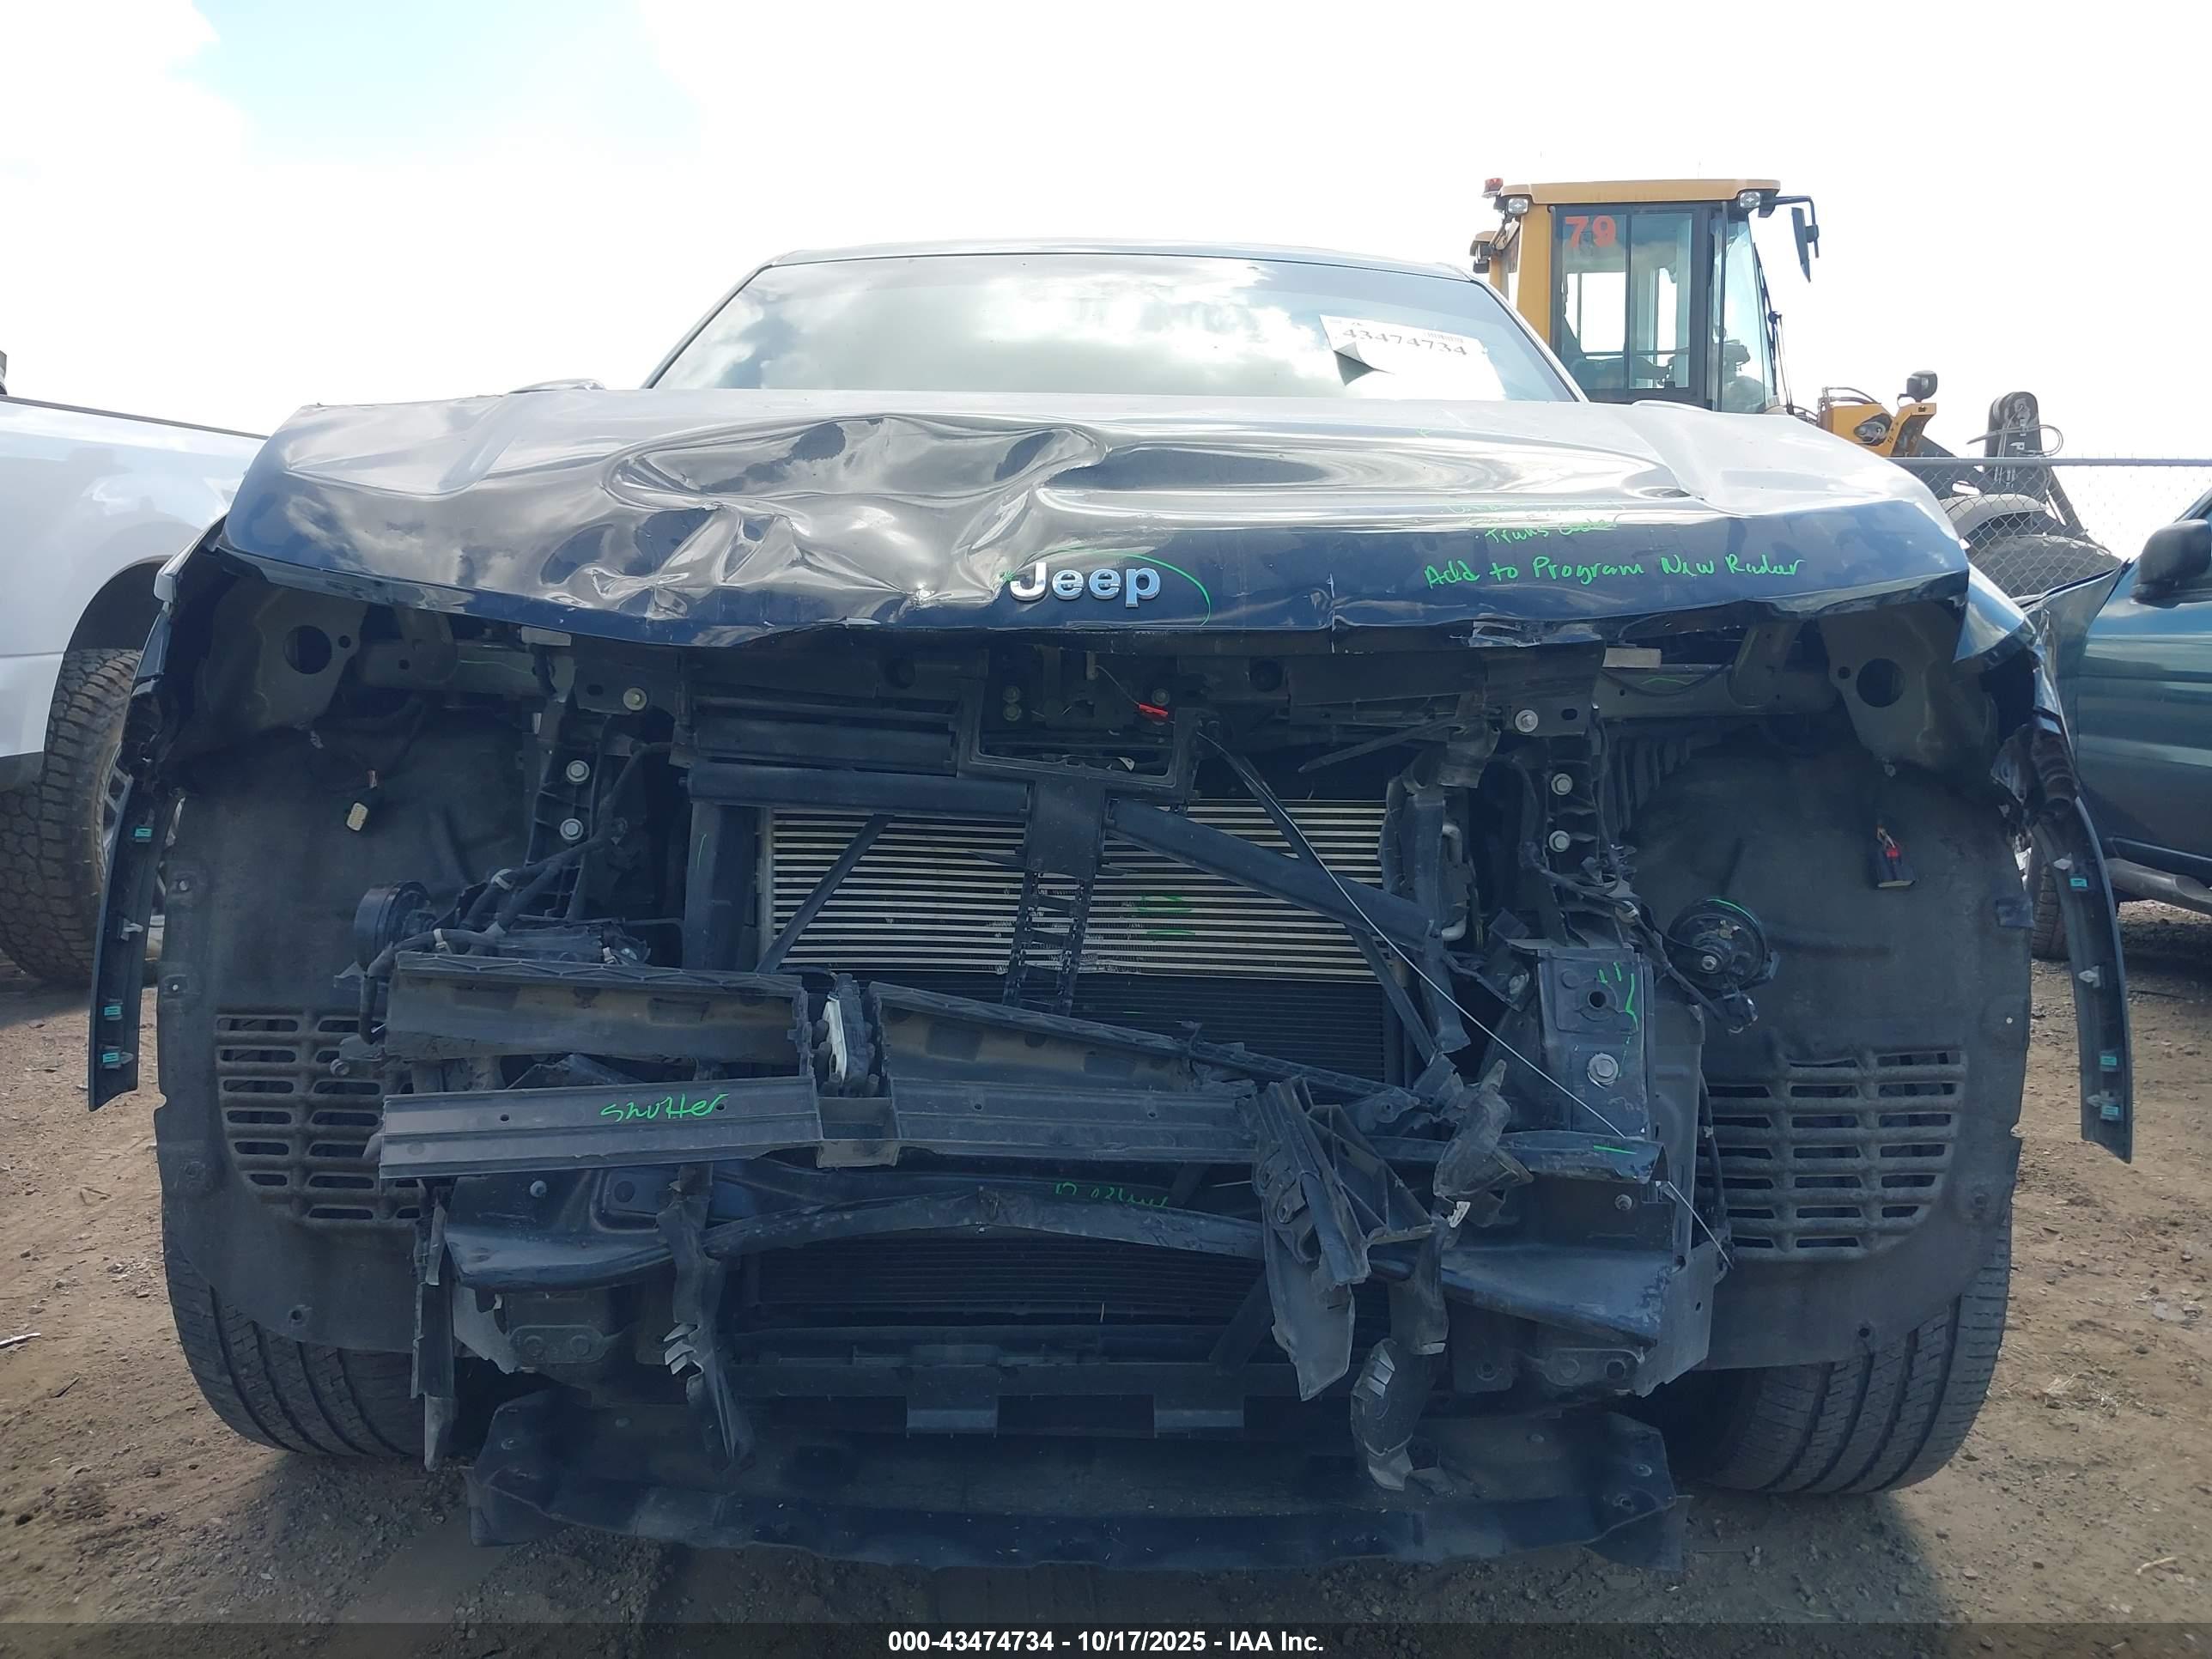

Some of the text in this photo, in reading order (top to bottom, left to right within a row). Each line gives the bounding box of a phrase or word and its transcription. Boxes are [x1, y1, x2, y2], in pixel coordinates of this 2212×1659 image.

[1565, 214, 1617, 249] 79
[1343, 329, 1468, 356] 43474734
[1010, 562, 1162, 608] Jeep
[1424, 560, 1480, 589] Add
[1489, 562, 1519, 581] to
[1532, 556, 1644, 586] Program
